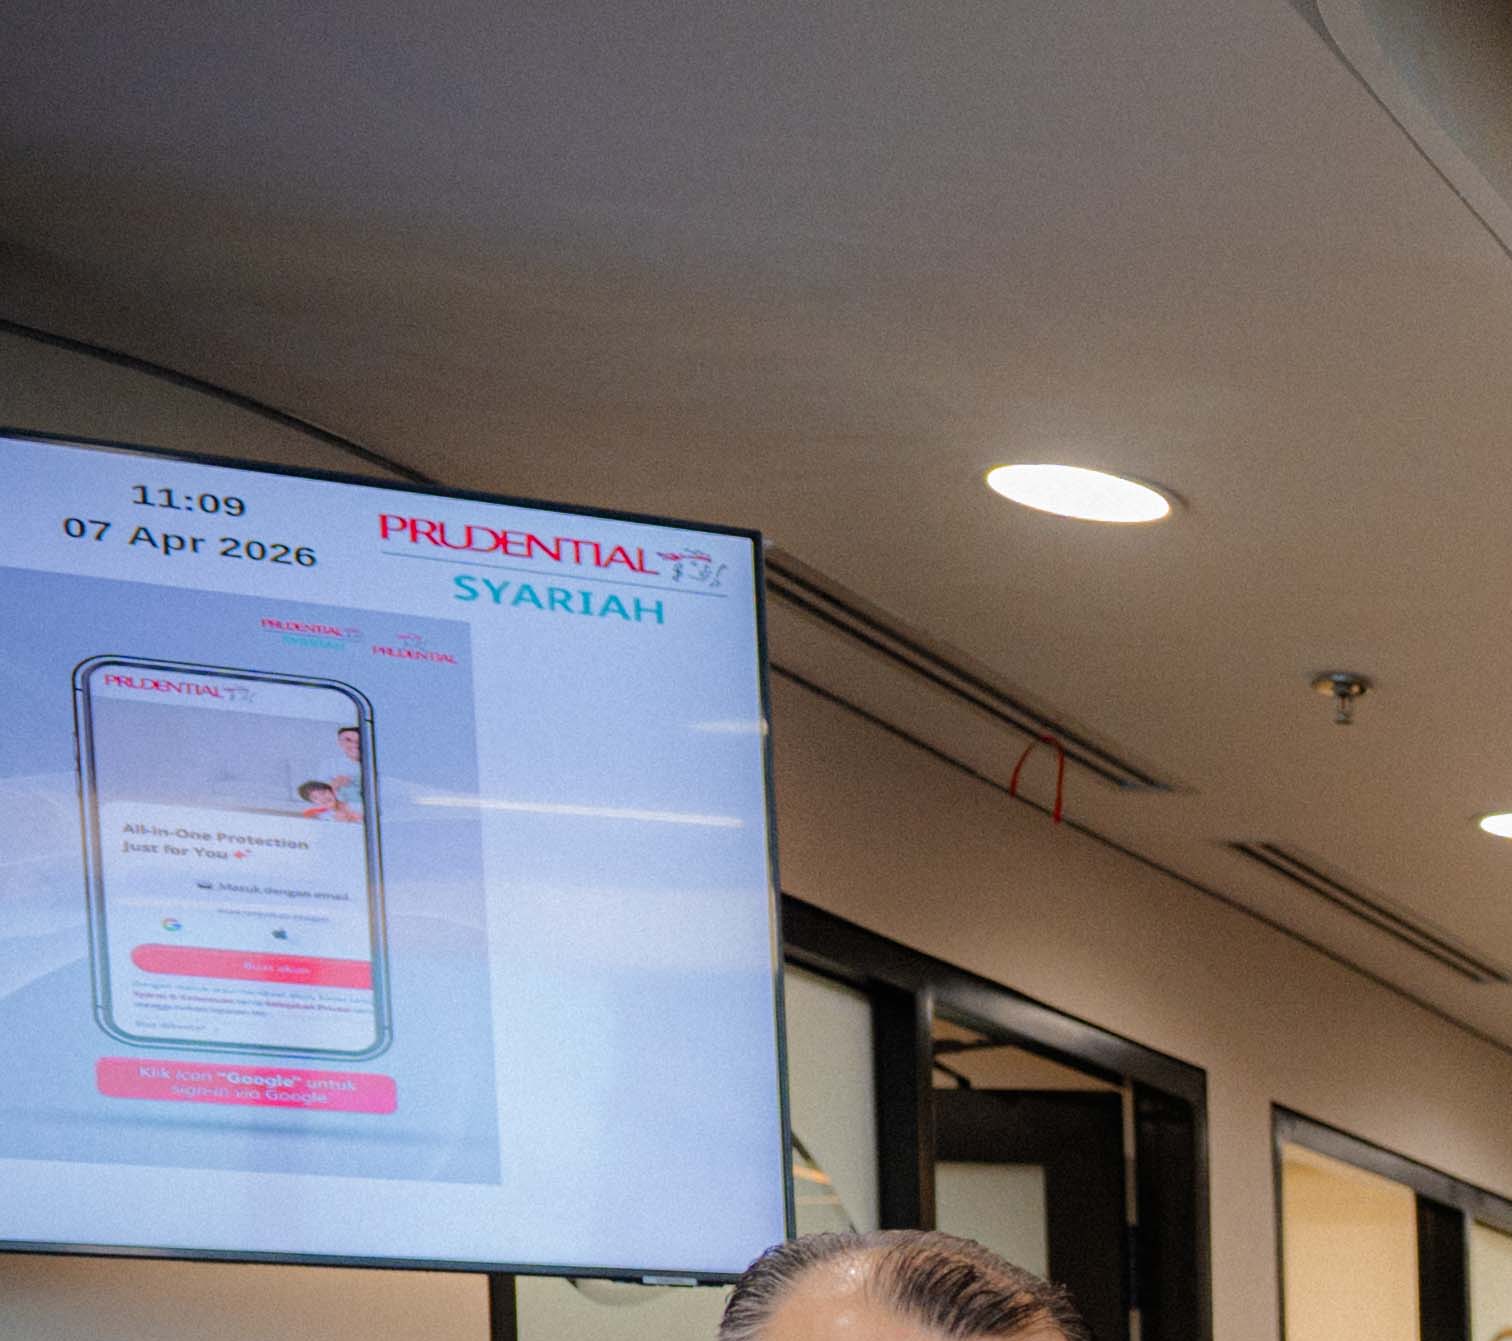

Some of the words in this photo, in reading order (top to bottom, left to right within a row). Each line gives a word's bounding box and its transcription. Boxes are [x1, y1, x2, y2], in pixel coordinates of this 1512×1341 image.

[131, 485, 245, 517] 11:09
[63, 517, 111, 542] 07
[129, 526, 205, 555] Apr
[219, 537, 317, 567] 2026
[379, 513, 659, 575] PRUDENTIAL
[453, 575, 664, 624] SYARIAH
[104, 674, 223, 698] PRUDENTIAL
[122, 841, 158, 854] Just
[196, 847, 228, 860] You
[217, 832, 309, 850] Protection
